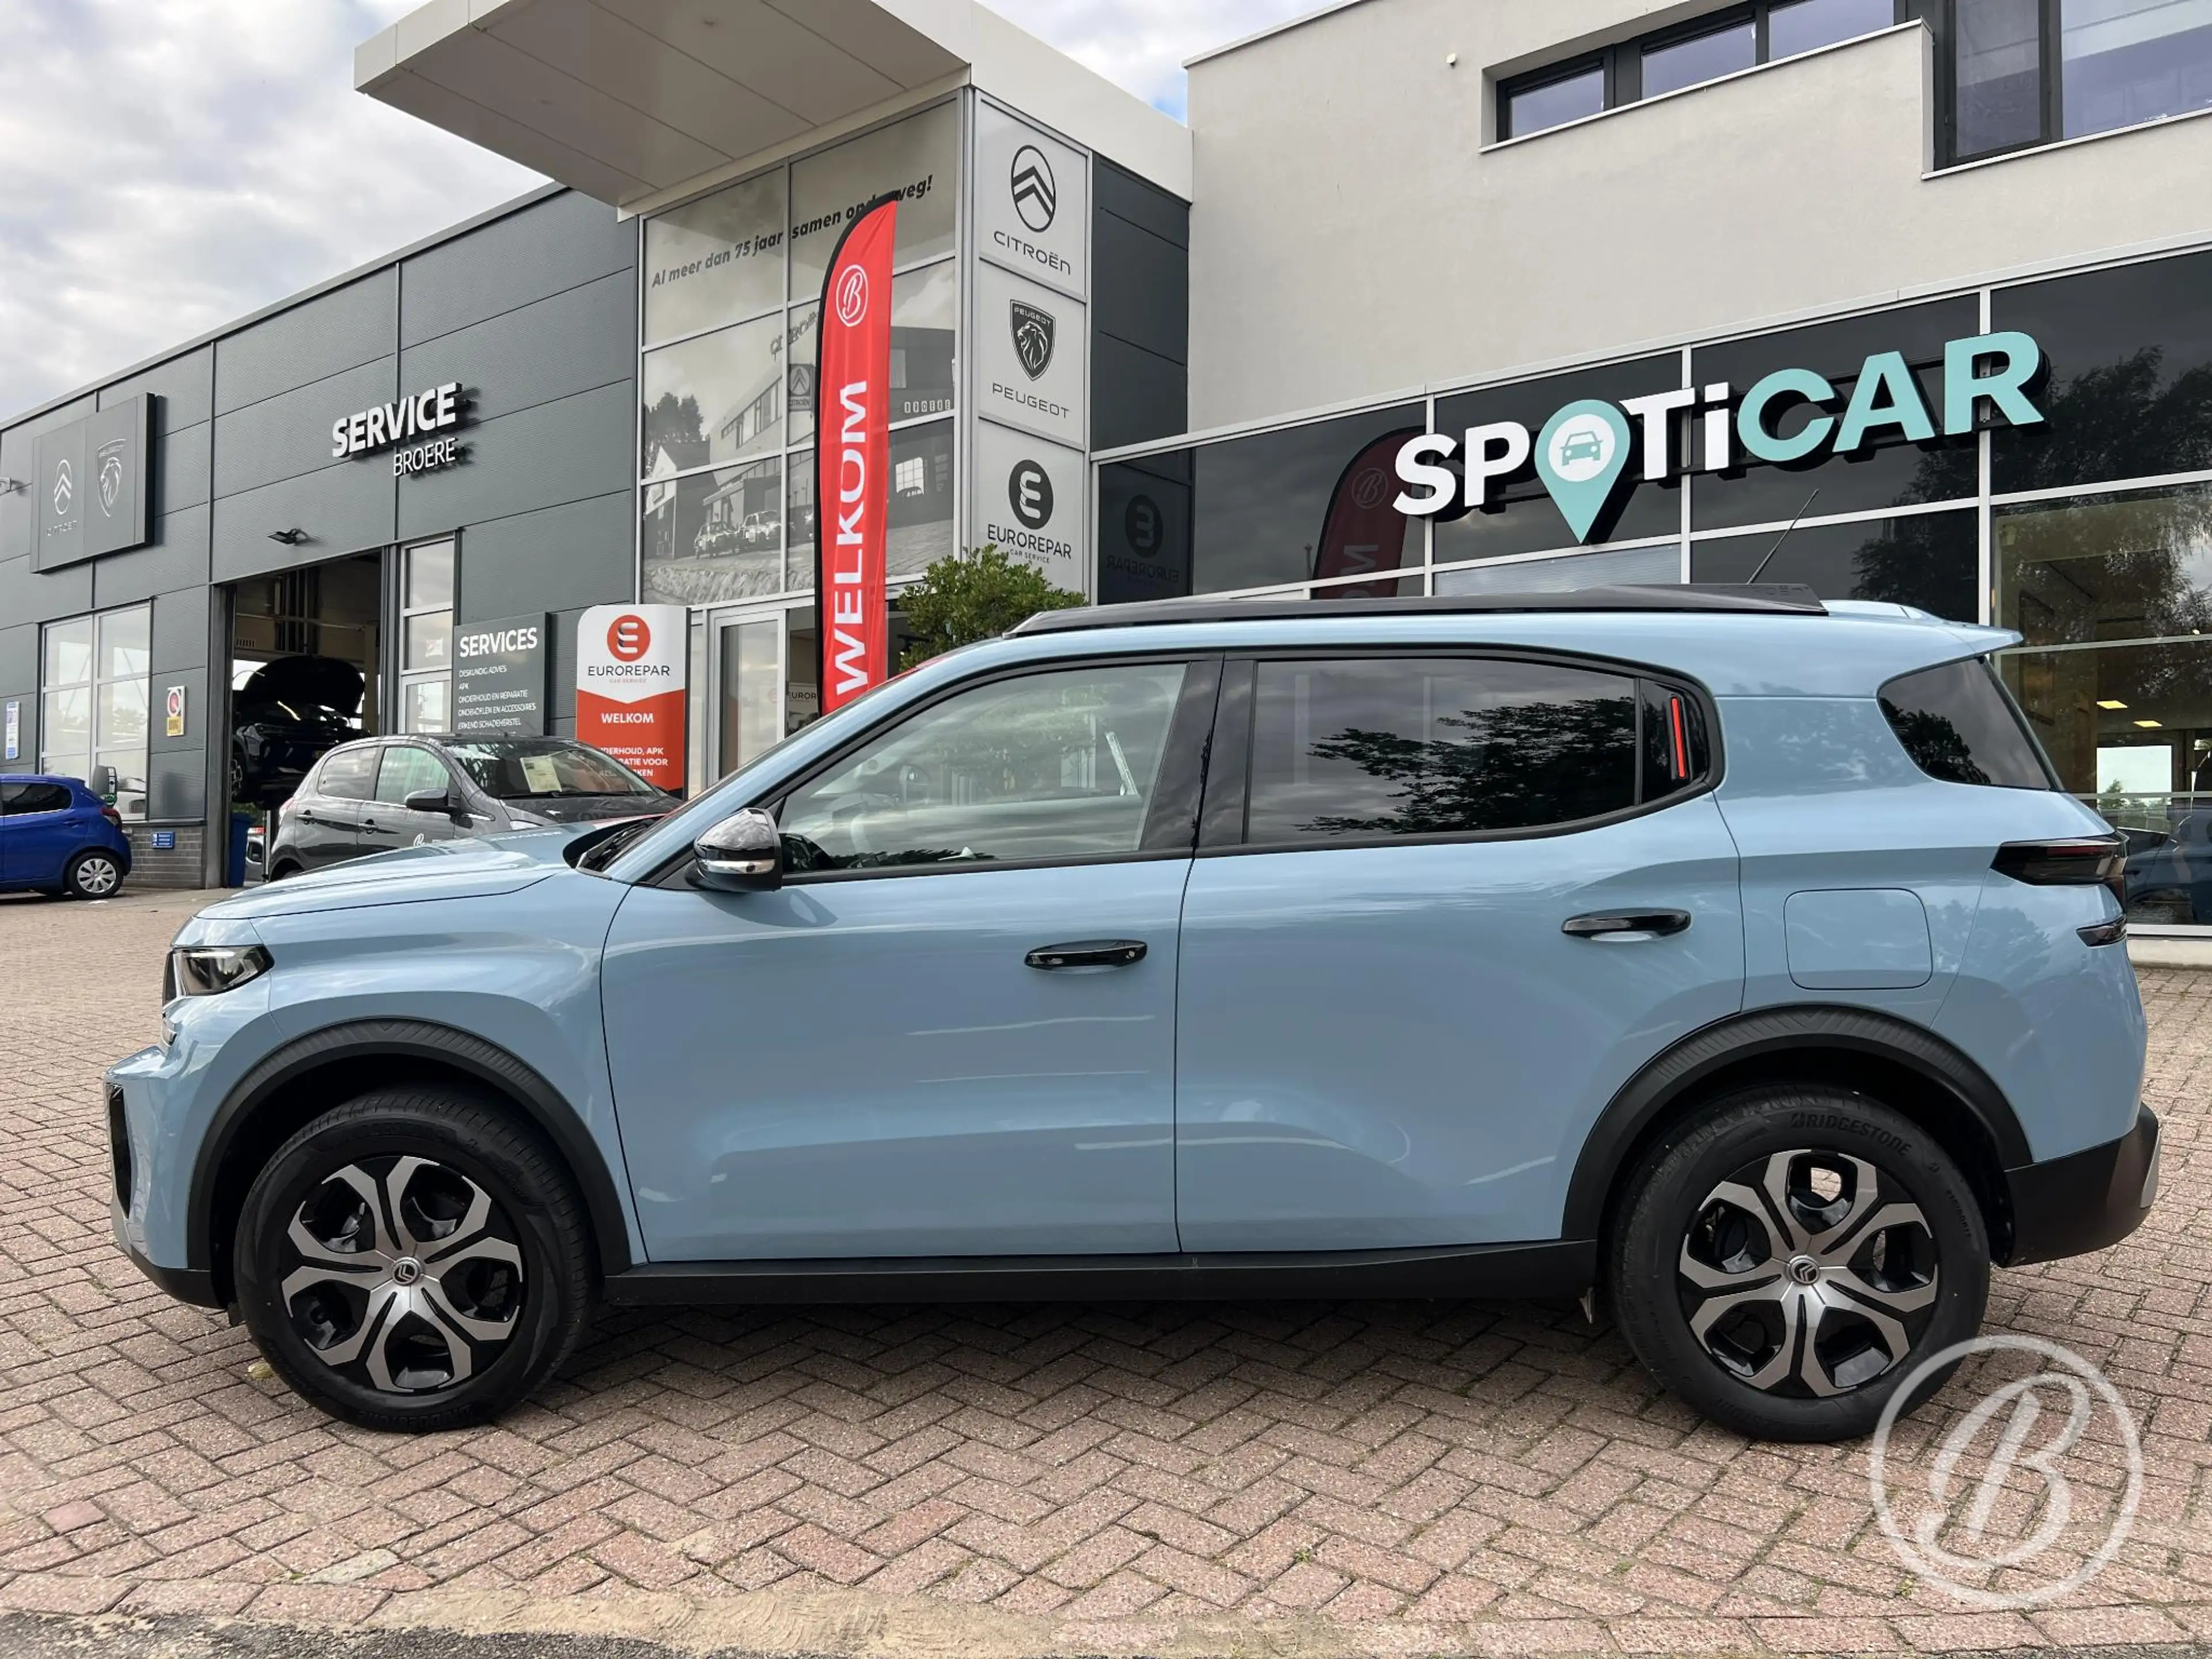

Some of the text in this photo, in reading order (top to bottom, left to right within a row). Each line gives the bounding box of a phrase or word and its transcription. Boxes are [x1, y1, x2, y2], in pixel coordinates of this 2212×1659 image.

[652, 270, 665, 287] Al
[669, 260, 702, 282] meer
[705, 251, 730, 268] dan
[735, 240, 751, 259] 75
[752, 231, 783, 257] jaar
[791, 211, 841, 240] samen
[993, 382, 1070, 418] PEUGEOT
[332, 382, 456, 458] SERVICE
[393, 437, 456, 476] BROERE
[834, 380, 869, 695] WELKOM
[988, 524, 1071, 560] EUROREPAR
[1024, 552, 1050, 564] SERVICE
[460, 627, 538, 658] SERVICES
[588, 665, 671, 676] EUROREPAR
[601, 713, 654, 724] WELKOM
[600, 747, 664, 756] DERHOUD, APK
[1791, 1112, 1912, 1157] BRIDGESTONE
